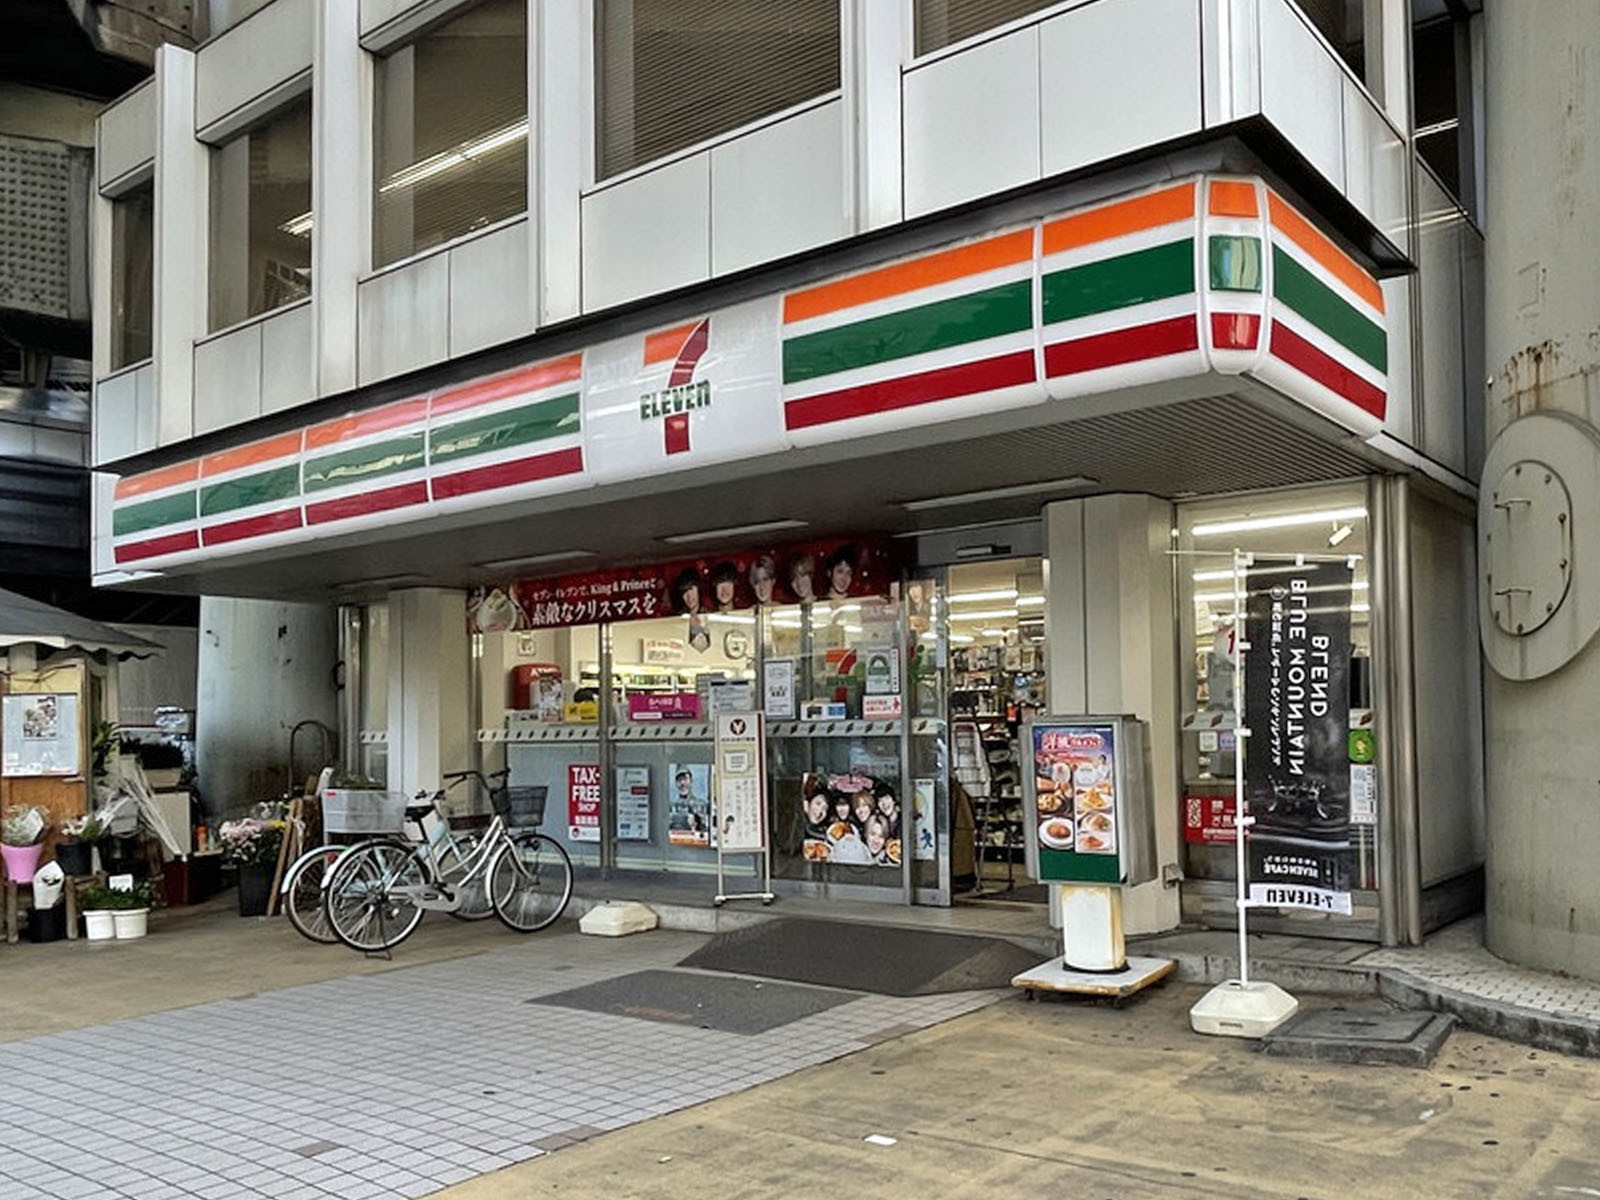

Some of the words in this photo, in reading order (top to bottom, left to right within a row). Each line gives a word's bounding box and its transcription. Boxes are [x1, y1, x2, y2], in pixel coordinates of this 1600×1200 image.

[644, 318, 710, 454] 7
[590, 584, 611, 595] King
[612, 581, 619, 592] &
[531, 592, 656, 626] 素敵なクリスマスを
[572, 785, 600, 802] FREE
